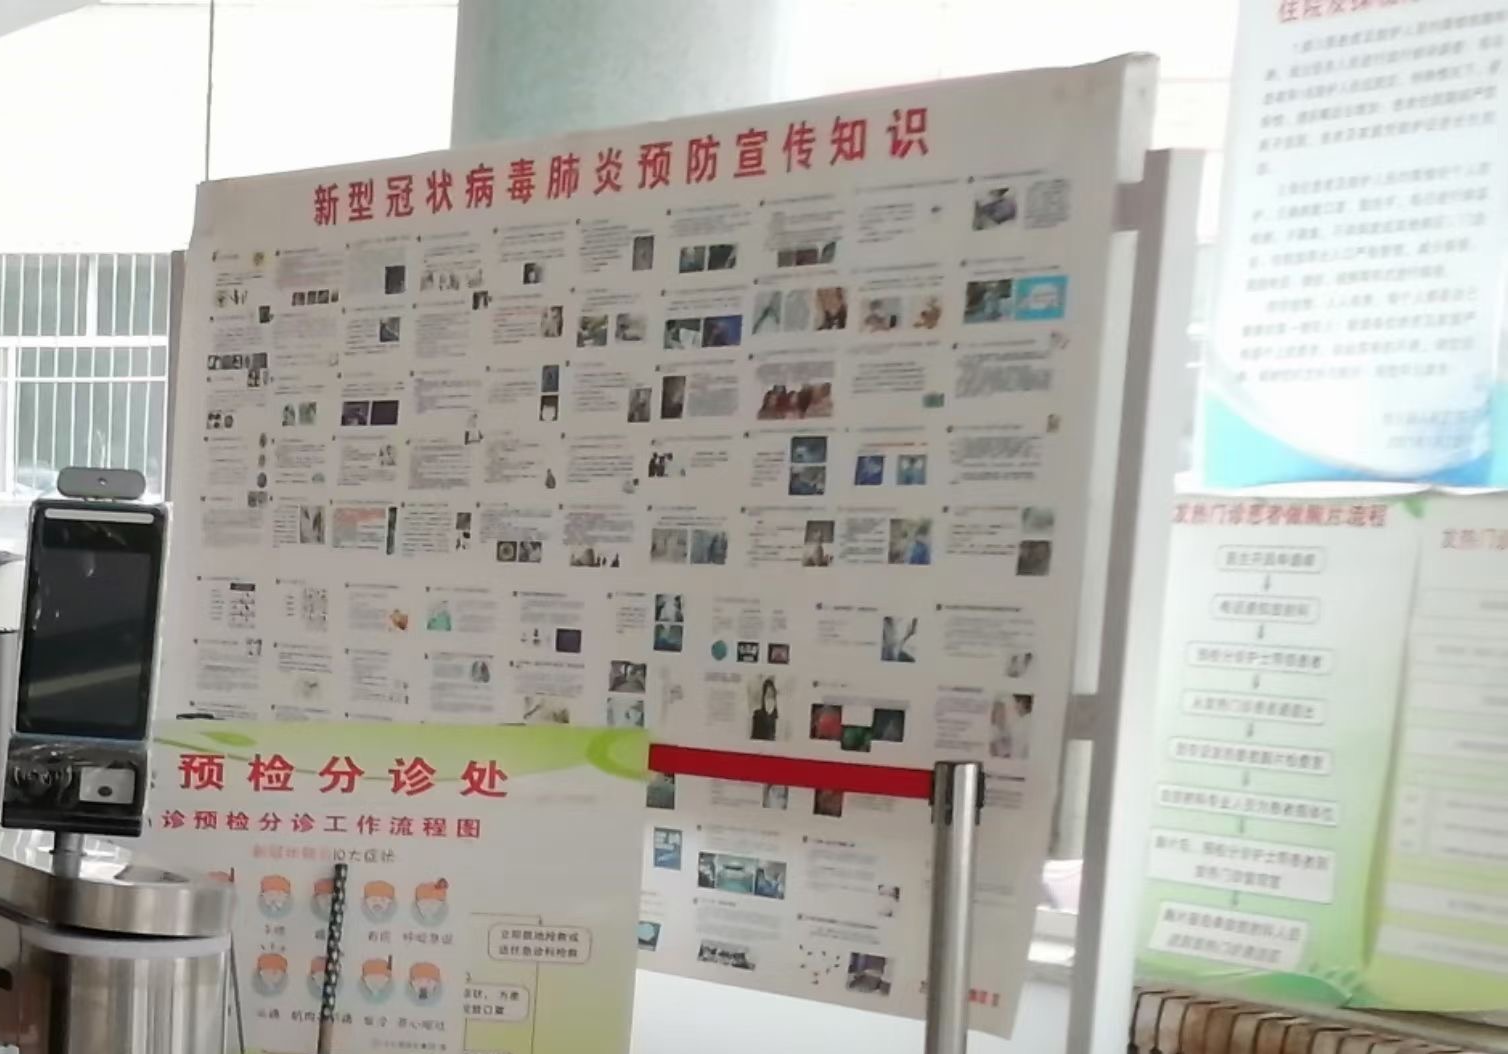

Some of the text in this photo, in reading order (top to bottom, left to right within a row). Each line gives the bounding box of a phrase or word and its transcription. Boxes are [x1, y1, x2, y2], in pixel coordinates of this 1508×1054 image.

[314, 108, 928, 226] 新型冠状病毒肺炎预防宣传知识
[178, 752, 509, 798] 预检分诊处
